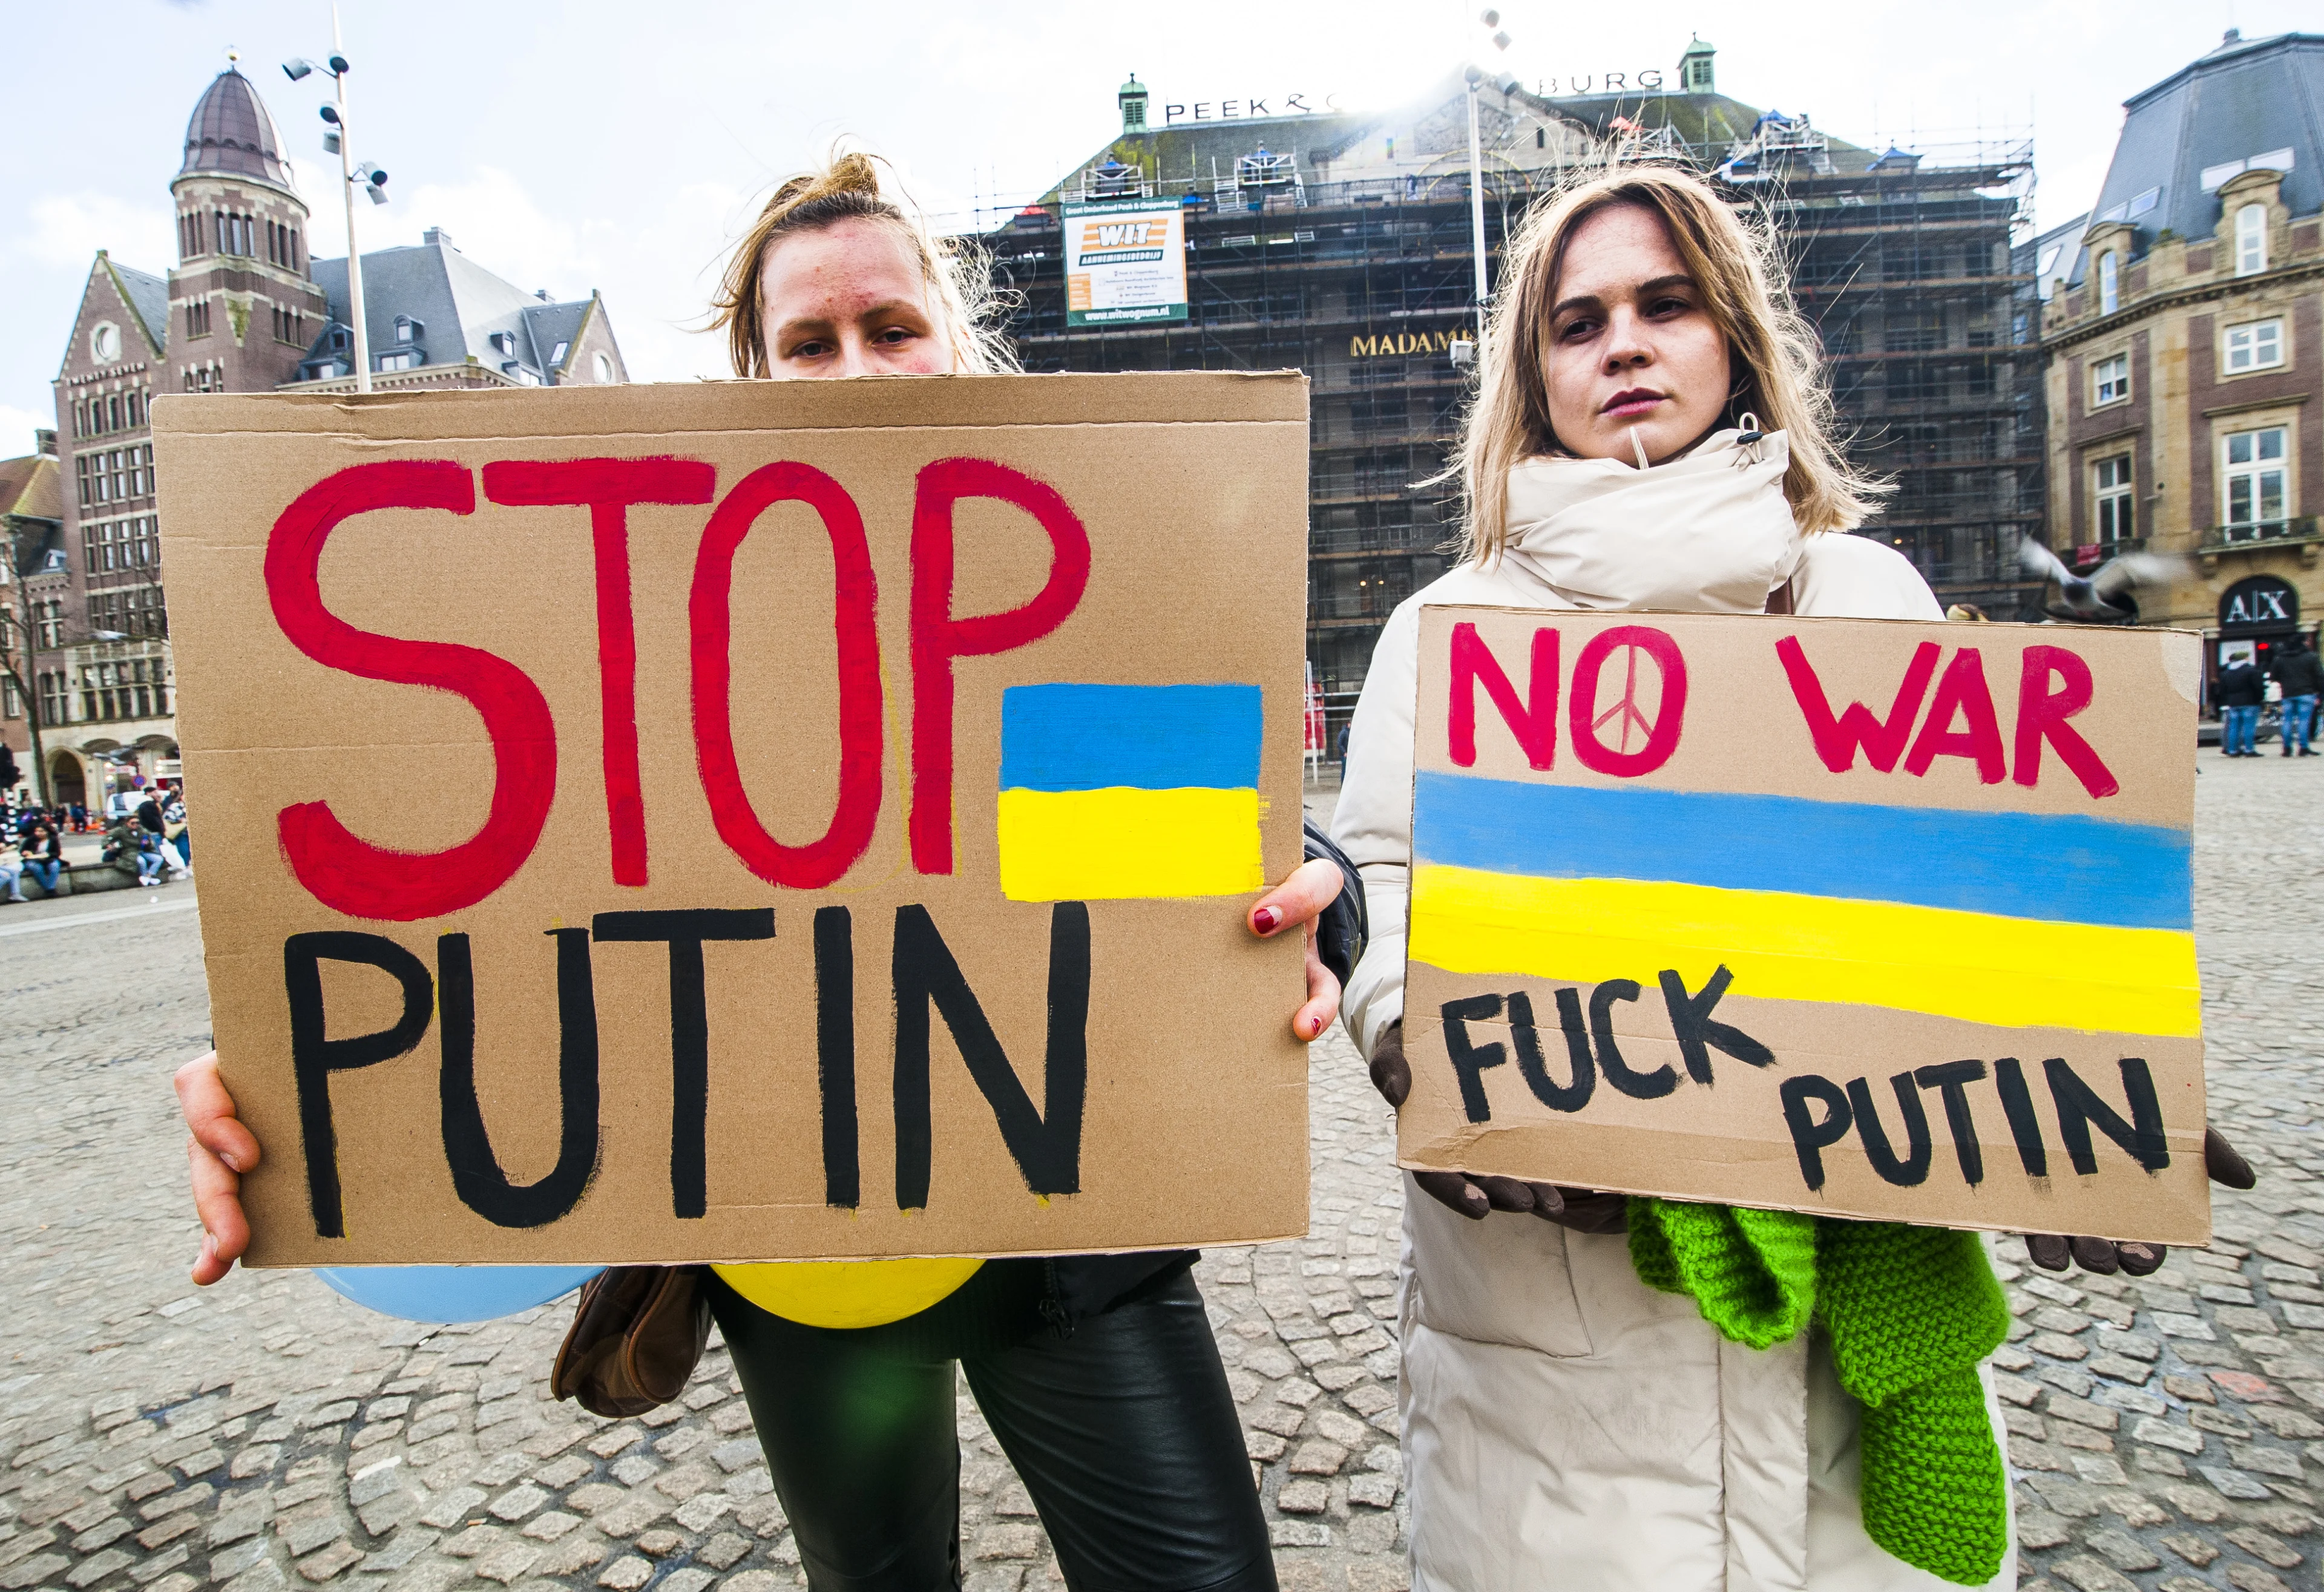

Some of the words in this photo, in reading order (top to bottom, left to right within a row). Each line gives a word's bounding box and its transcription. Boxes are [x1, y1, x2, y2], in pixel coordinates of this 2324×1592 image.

[1166, 99, 1270, 123] PEEK
[1285, 93, 1312, 114] &
[1097, 221, 1152, 247] WIT
[264, 455, 1091, 922] STOP
[1449, 623, 1687, 778] NO
[1776, 635, 2119, 799] WAR
[284, 902, 1091, 1239] PUTIN
[1442, 964, 1777, 1124] FUCK
[1780, 1058, 2170, 1193] PUTIN
